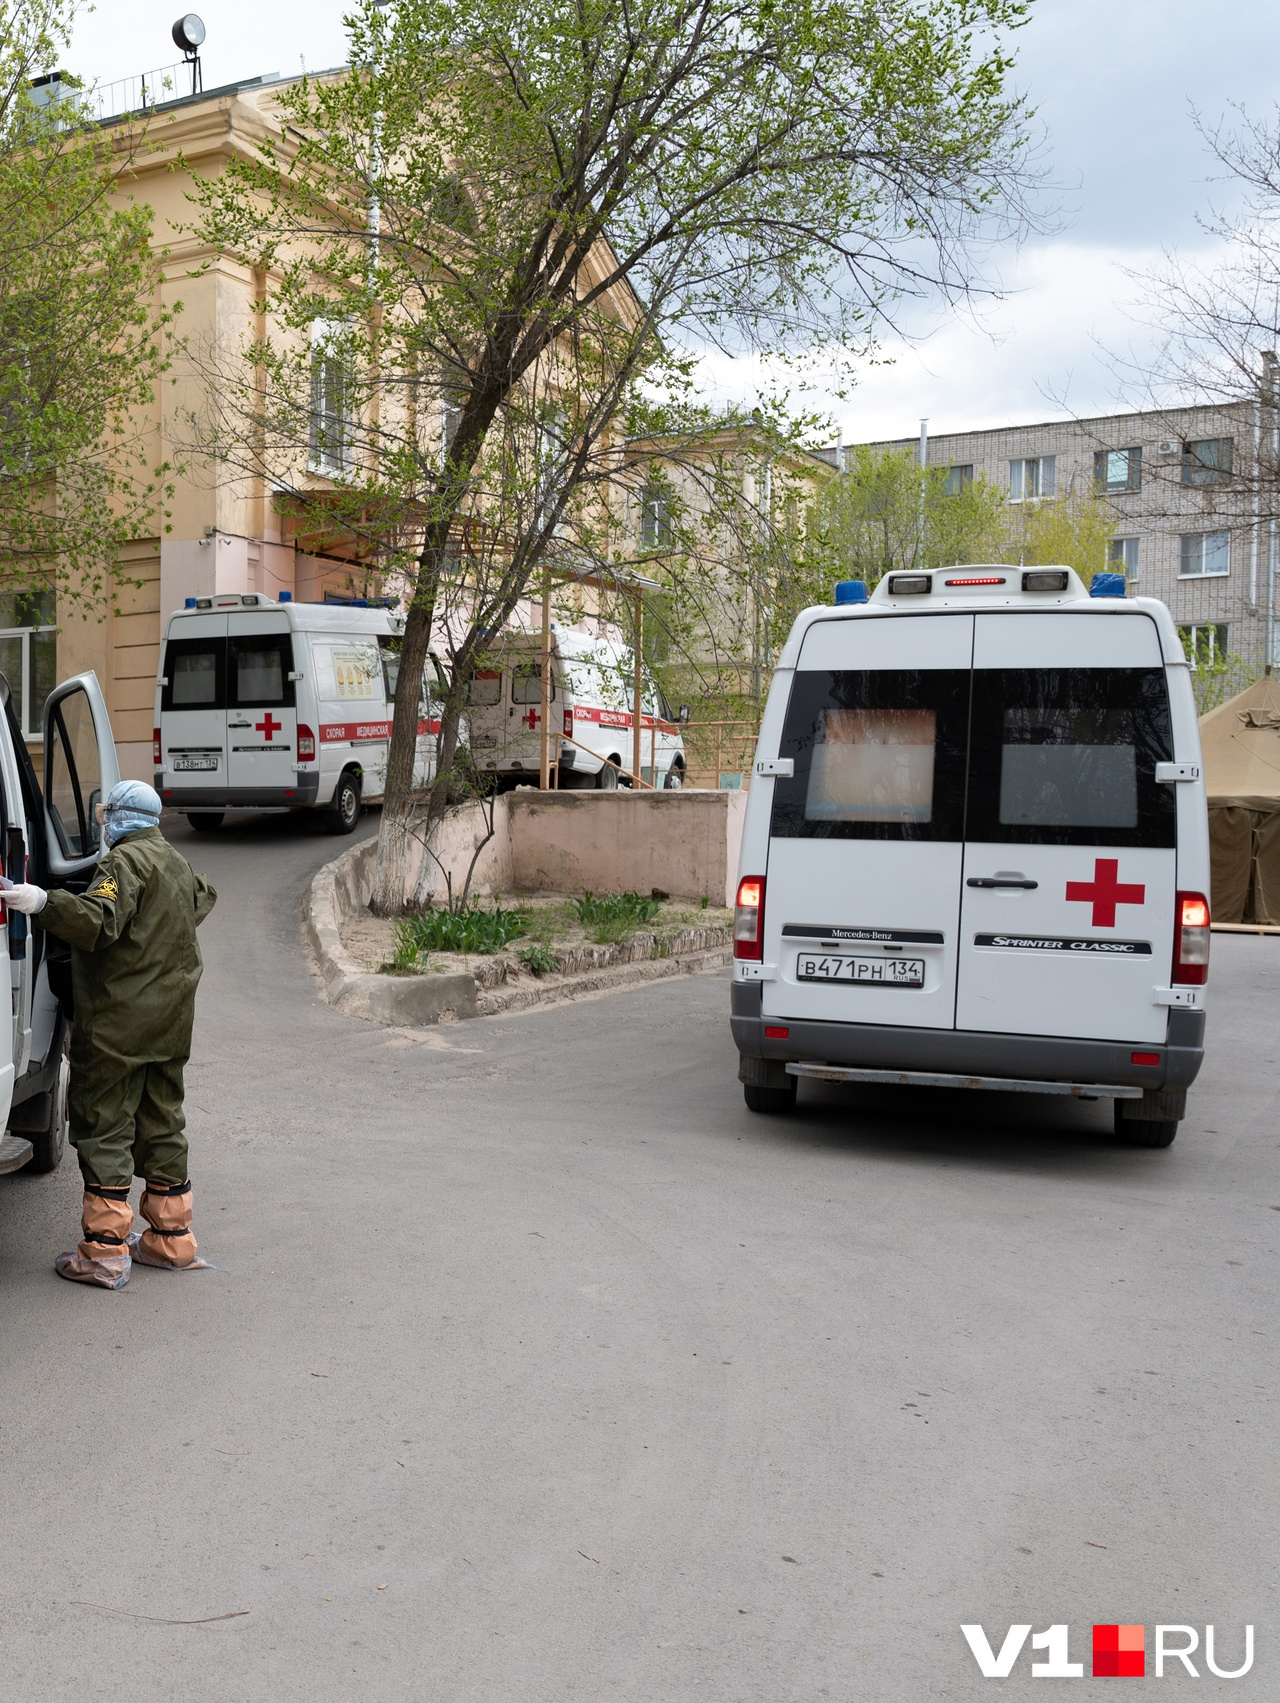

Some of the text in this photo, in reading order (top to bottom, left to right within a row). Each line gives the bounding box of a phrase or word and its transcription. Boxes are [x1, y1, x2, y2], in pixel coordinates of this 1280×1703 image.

[600, 712, 626, 724] МЕДСКАЯ
[325, 725, 389, 739] СКОРАЯ МЕДИЦИНСКАЯ
[832, 929, 892, 940] Mercedes-Benz
[992, 936, 1135, 952] SPRINTER CLASSIC
[805, 958, 918, 979] В471РН 134
